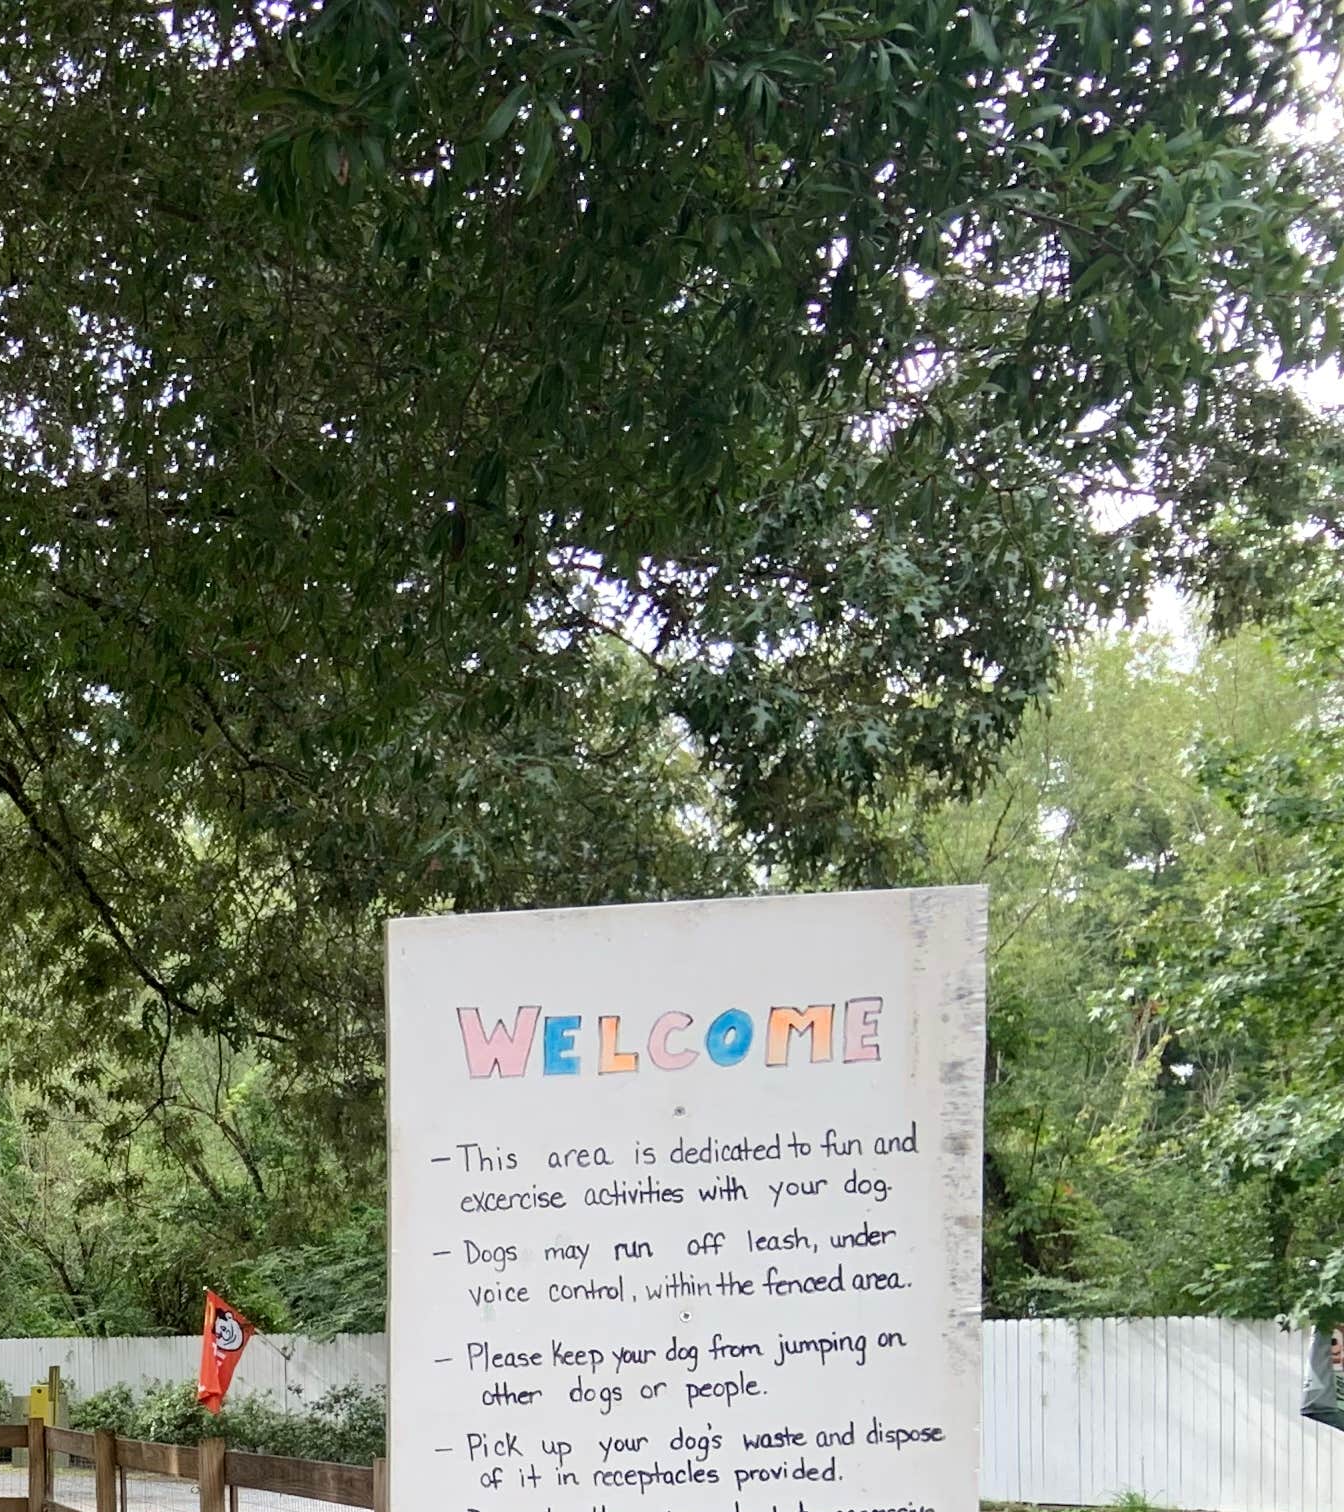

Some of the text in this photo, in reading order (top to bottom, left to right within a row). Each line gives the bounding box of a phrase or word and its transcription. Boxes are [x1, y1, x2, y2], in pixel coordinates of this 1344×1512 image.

[456, 996, 884, 1079] WELCOME
[456, 1122, 919, 1172] This area is dedicated to fun and
[461, 1168, 892, 1213] excercise activities with your dog.
[463, 1221, 896, 1272] Dogs may run off leash, under
[468, 1282, 530, 1307] voice
[645, 1271, 712, 1300] within
[715, 1271, 755, 1296] the
[762, 1263, 846, 1296] fenced
[852, 1272, 912, 1291] area.
[467, 1341, 542, 1372] Please
[612, 1347, 656, 1374] your
[666, 1336, 698, 1372] dog
[708, 1333, 764, 1360] from
[774, 1331, 867, 1366] jumping
[877, 1332, 907, 1347] on
[482, 1370, 767, 1415] other dogs or people.
[466, 1416, 946, 1468] Pick up your dog's waste and dispose
[480, 1456, 843, 1495] of it in receptacles provided.
